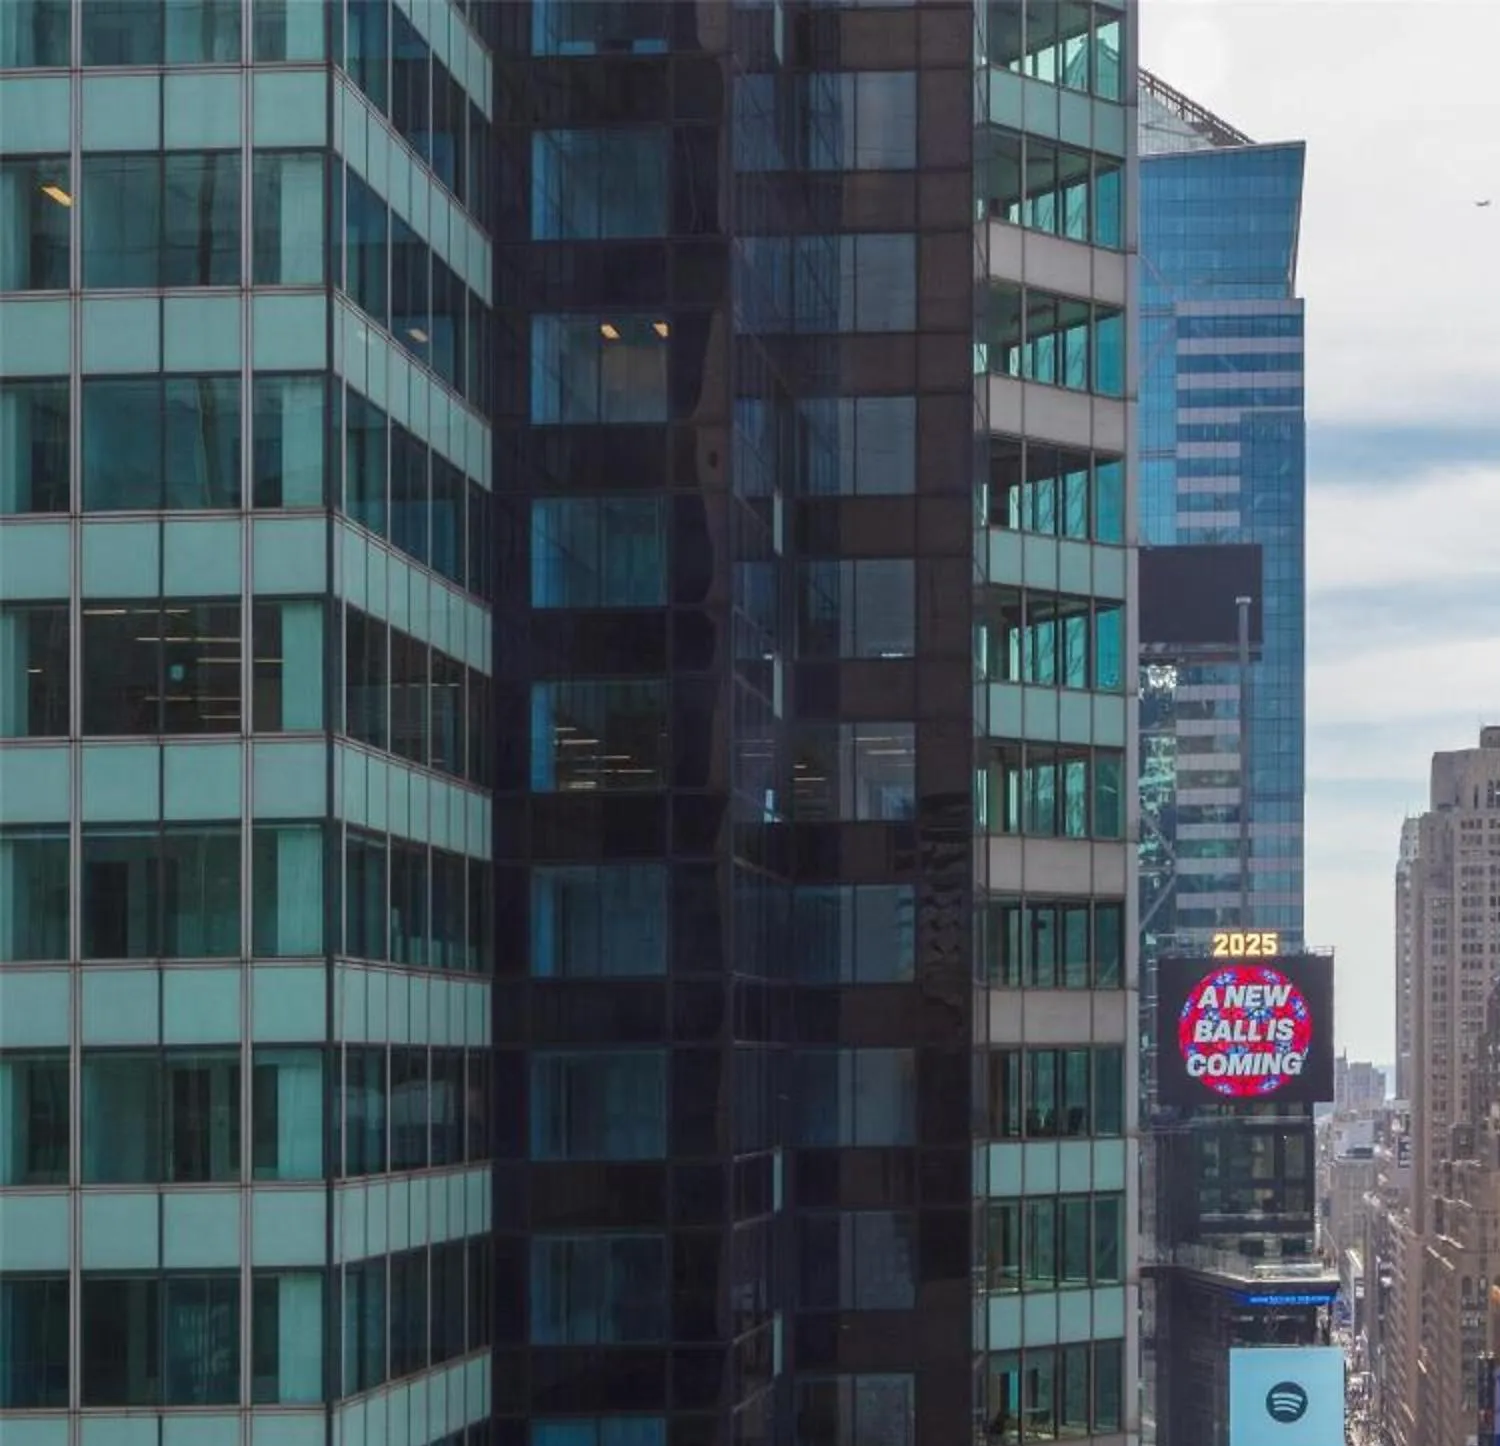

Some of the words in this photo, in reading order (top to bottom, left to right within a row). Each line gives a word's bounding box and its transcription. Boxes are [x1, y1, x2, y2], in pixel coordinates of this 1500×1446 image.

[1213, 933, 1278, 955] 2025
[1197, 985, 1218, 1008] A
[1224, 985, 1292, 1008] NEW
[1194, 1019, 1262, 1043] BALL
[1267, 1018, 1294, 1041] IS
